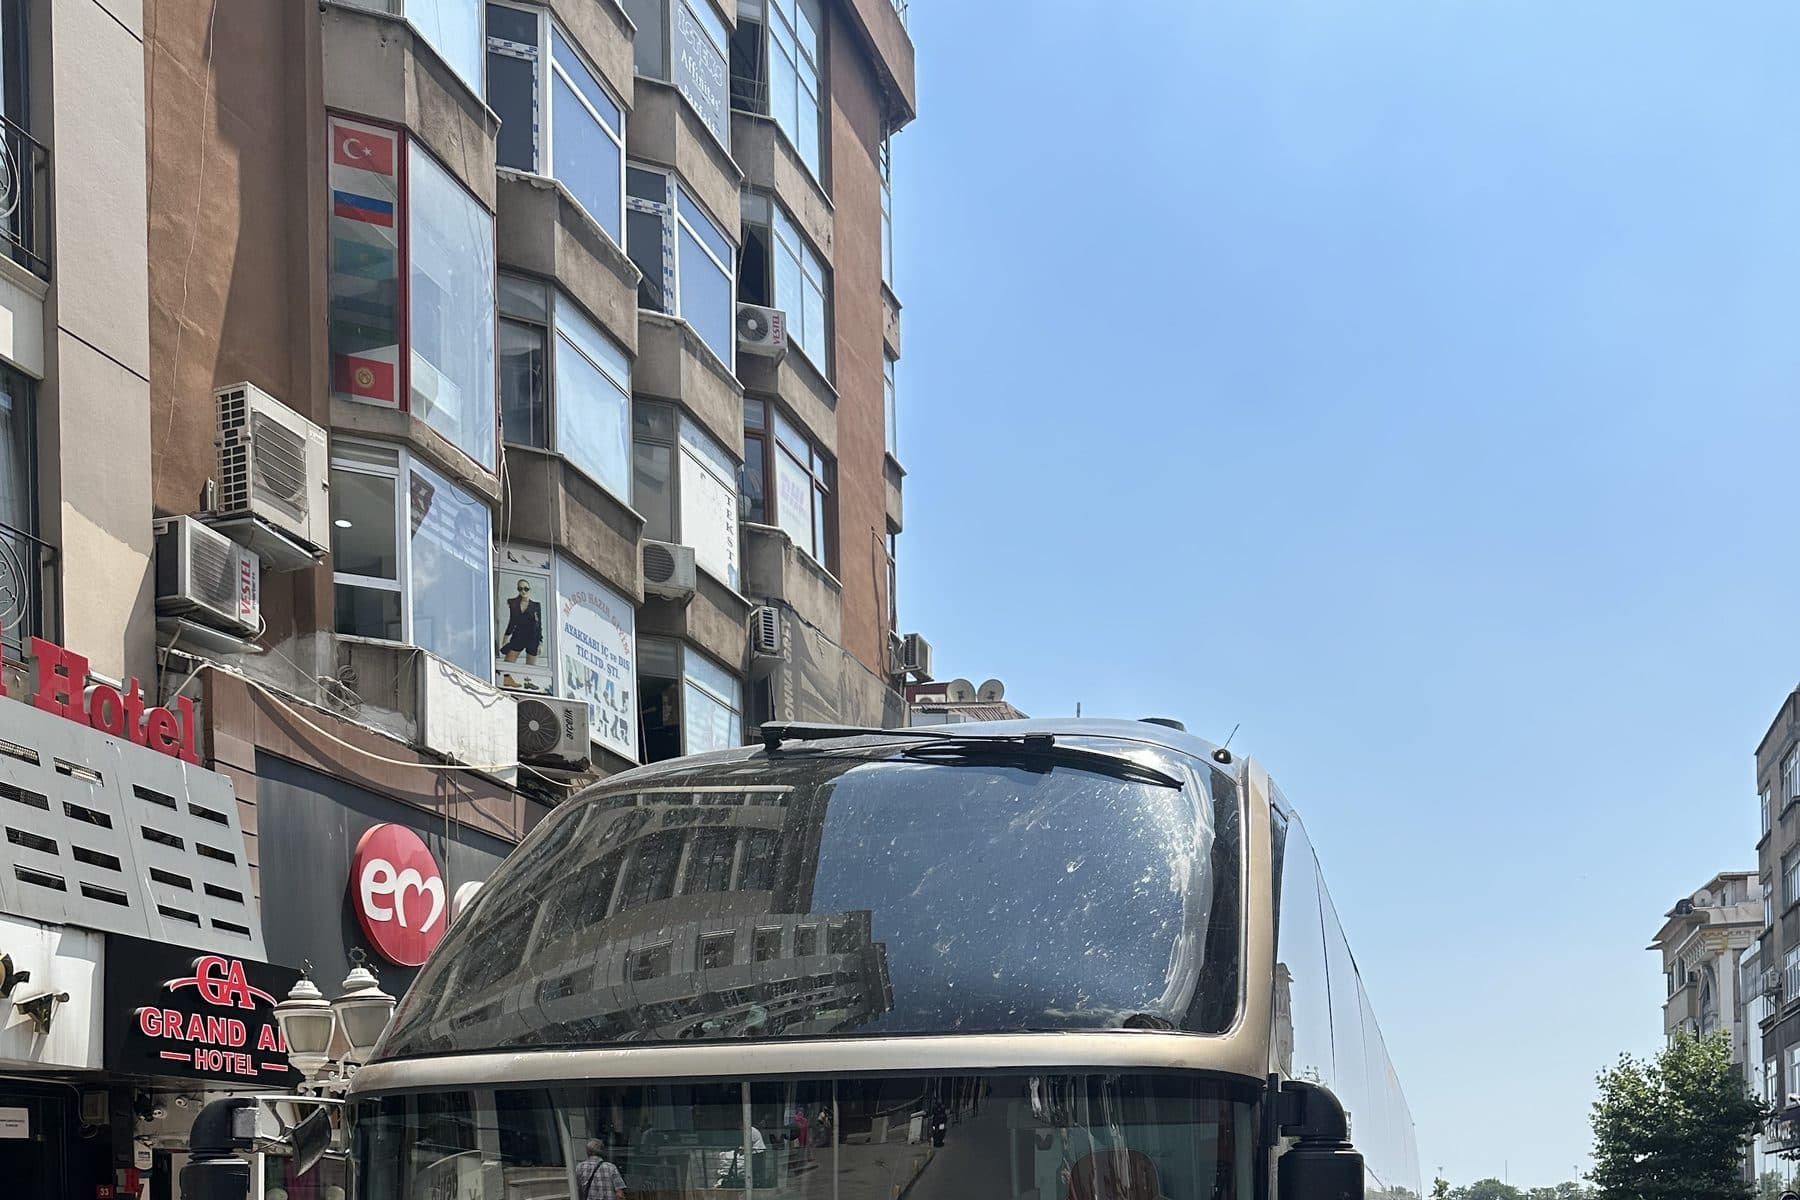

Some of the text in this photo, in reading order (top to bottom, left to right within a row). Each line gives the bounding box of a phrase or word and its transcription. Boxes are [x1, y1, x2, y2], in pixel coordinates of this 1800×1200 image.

[772, 314, 780, 345] VESTEL
[240, 559, 251, 615] VESTEL
[564, 622, 600, 653] AYAKKABI
[31, 636, 200, 767] Hotel
[139, 1006, 246, 1047] GRAND
[194, 1047, 258, 1076] HOTEL
